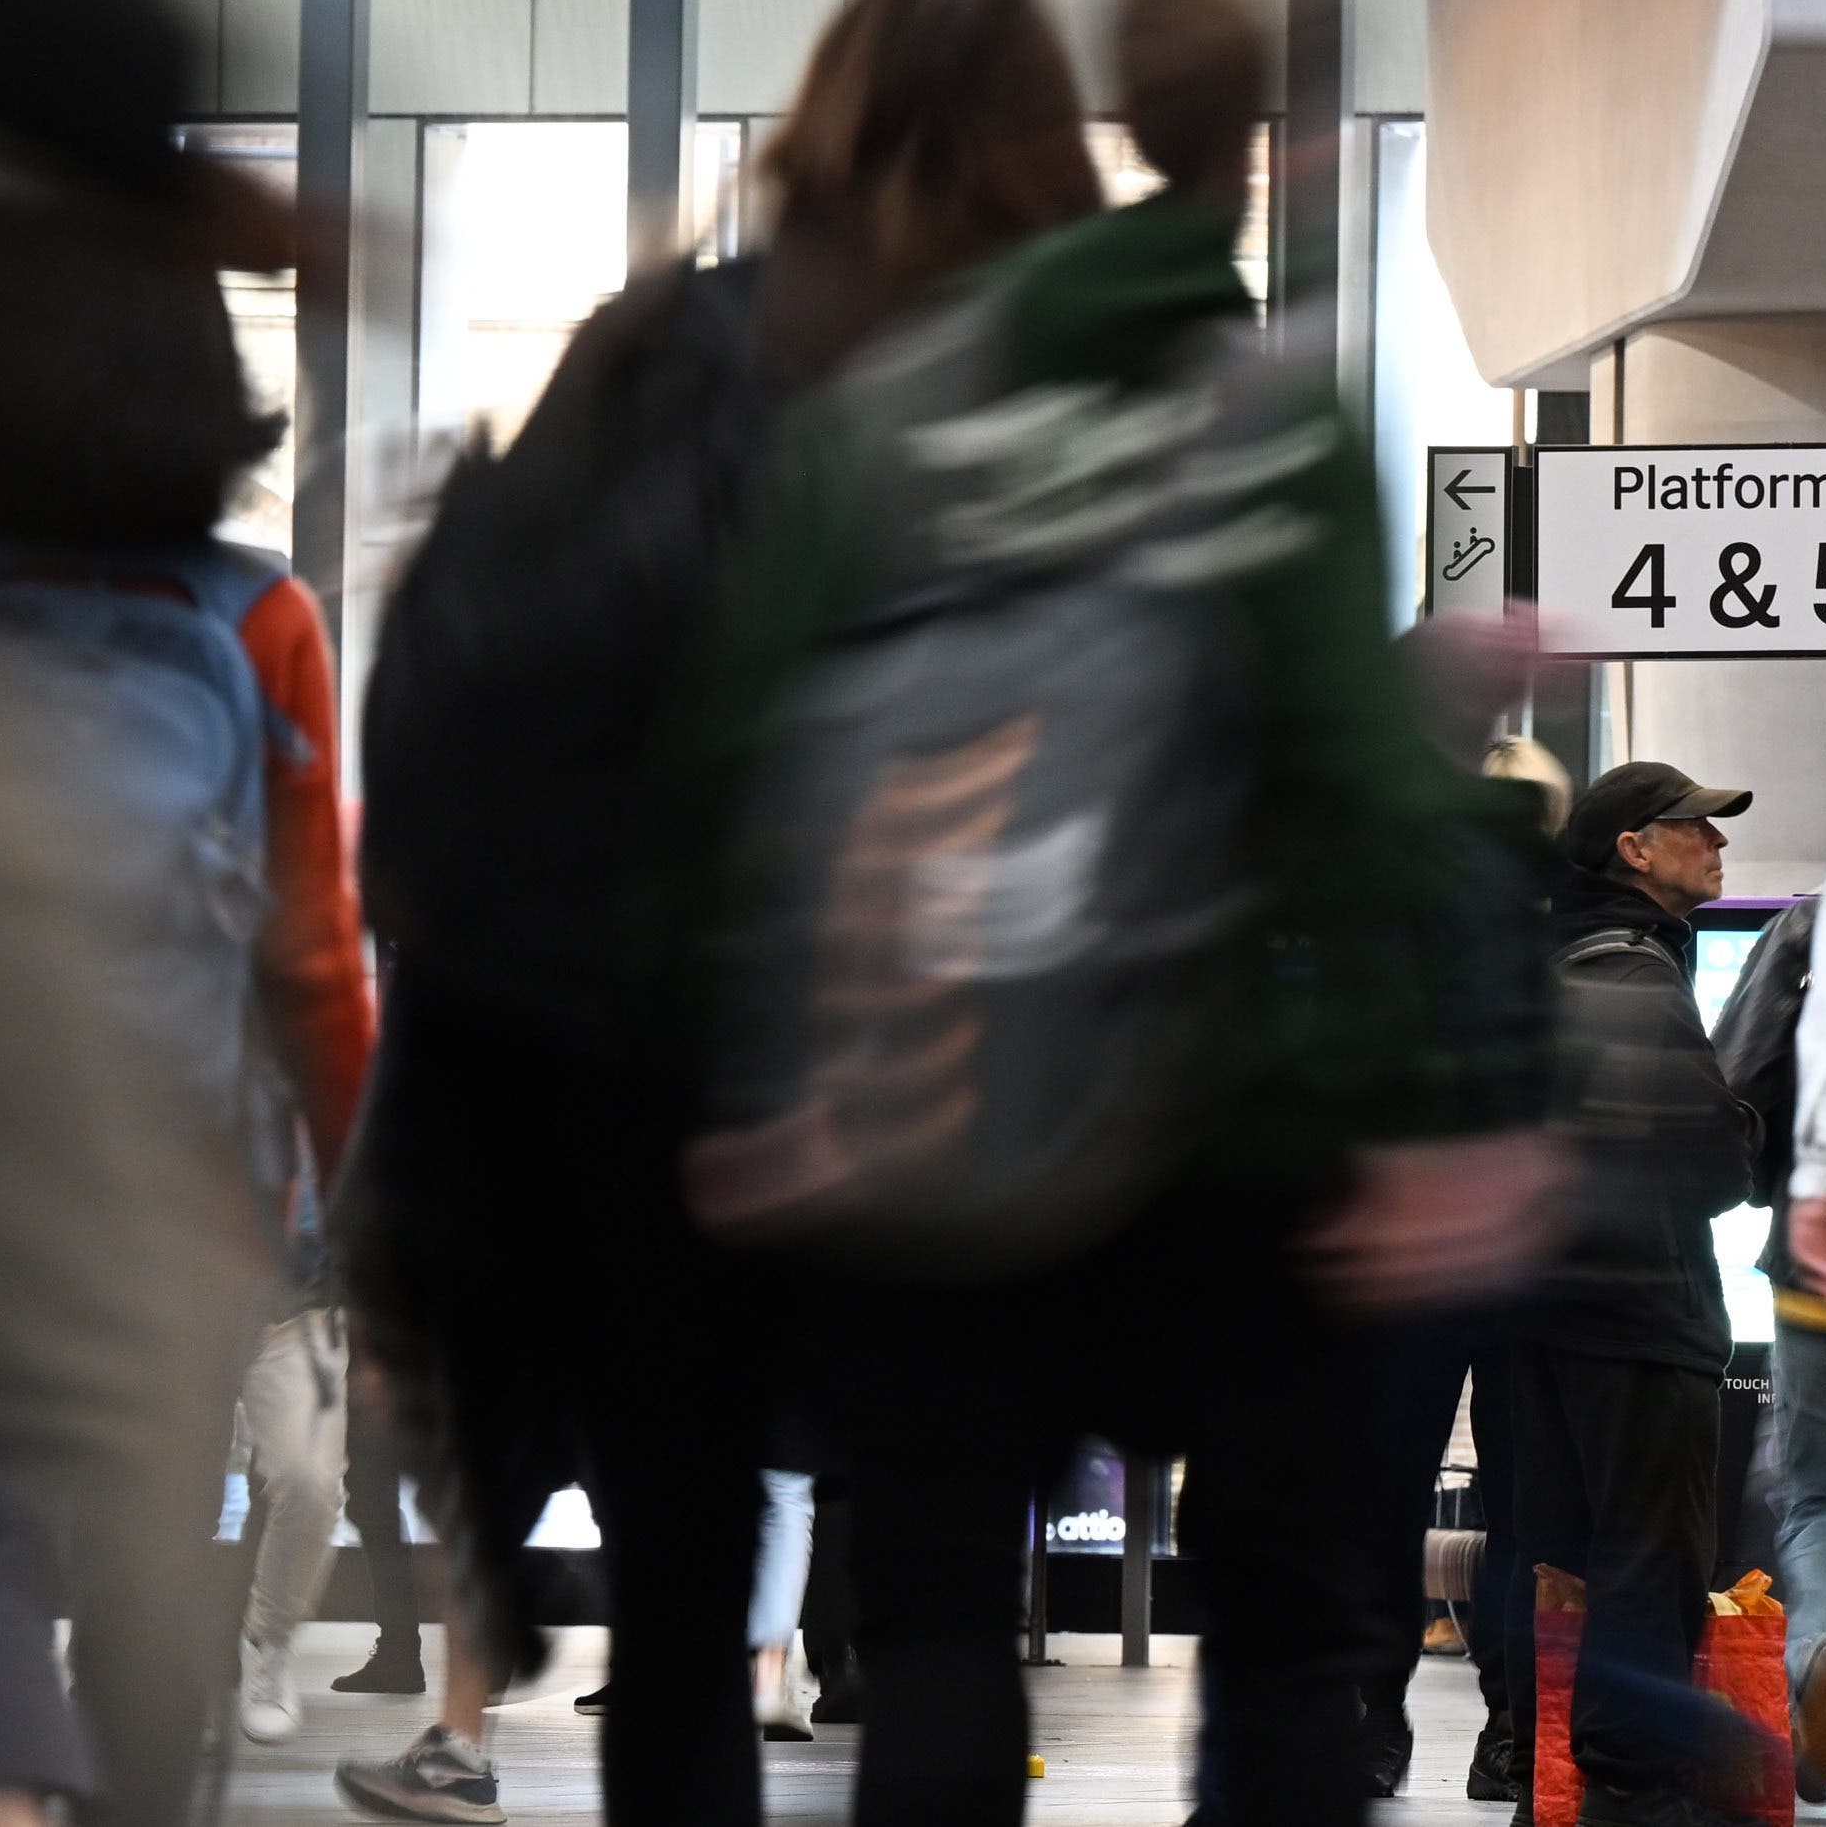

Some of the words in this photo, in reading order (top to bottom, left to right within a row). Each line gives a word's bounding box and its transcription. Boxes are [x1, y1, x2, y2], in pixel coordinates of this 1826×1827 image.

[1611, 543, 1676, 628] 4
[1709, 541, 1780, 629] &
[1725, 1378, 1770, 1390] TOUCH
[1057, 1508, 1126, 1541] attio
